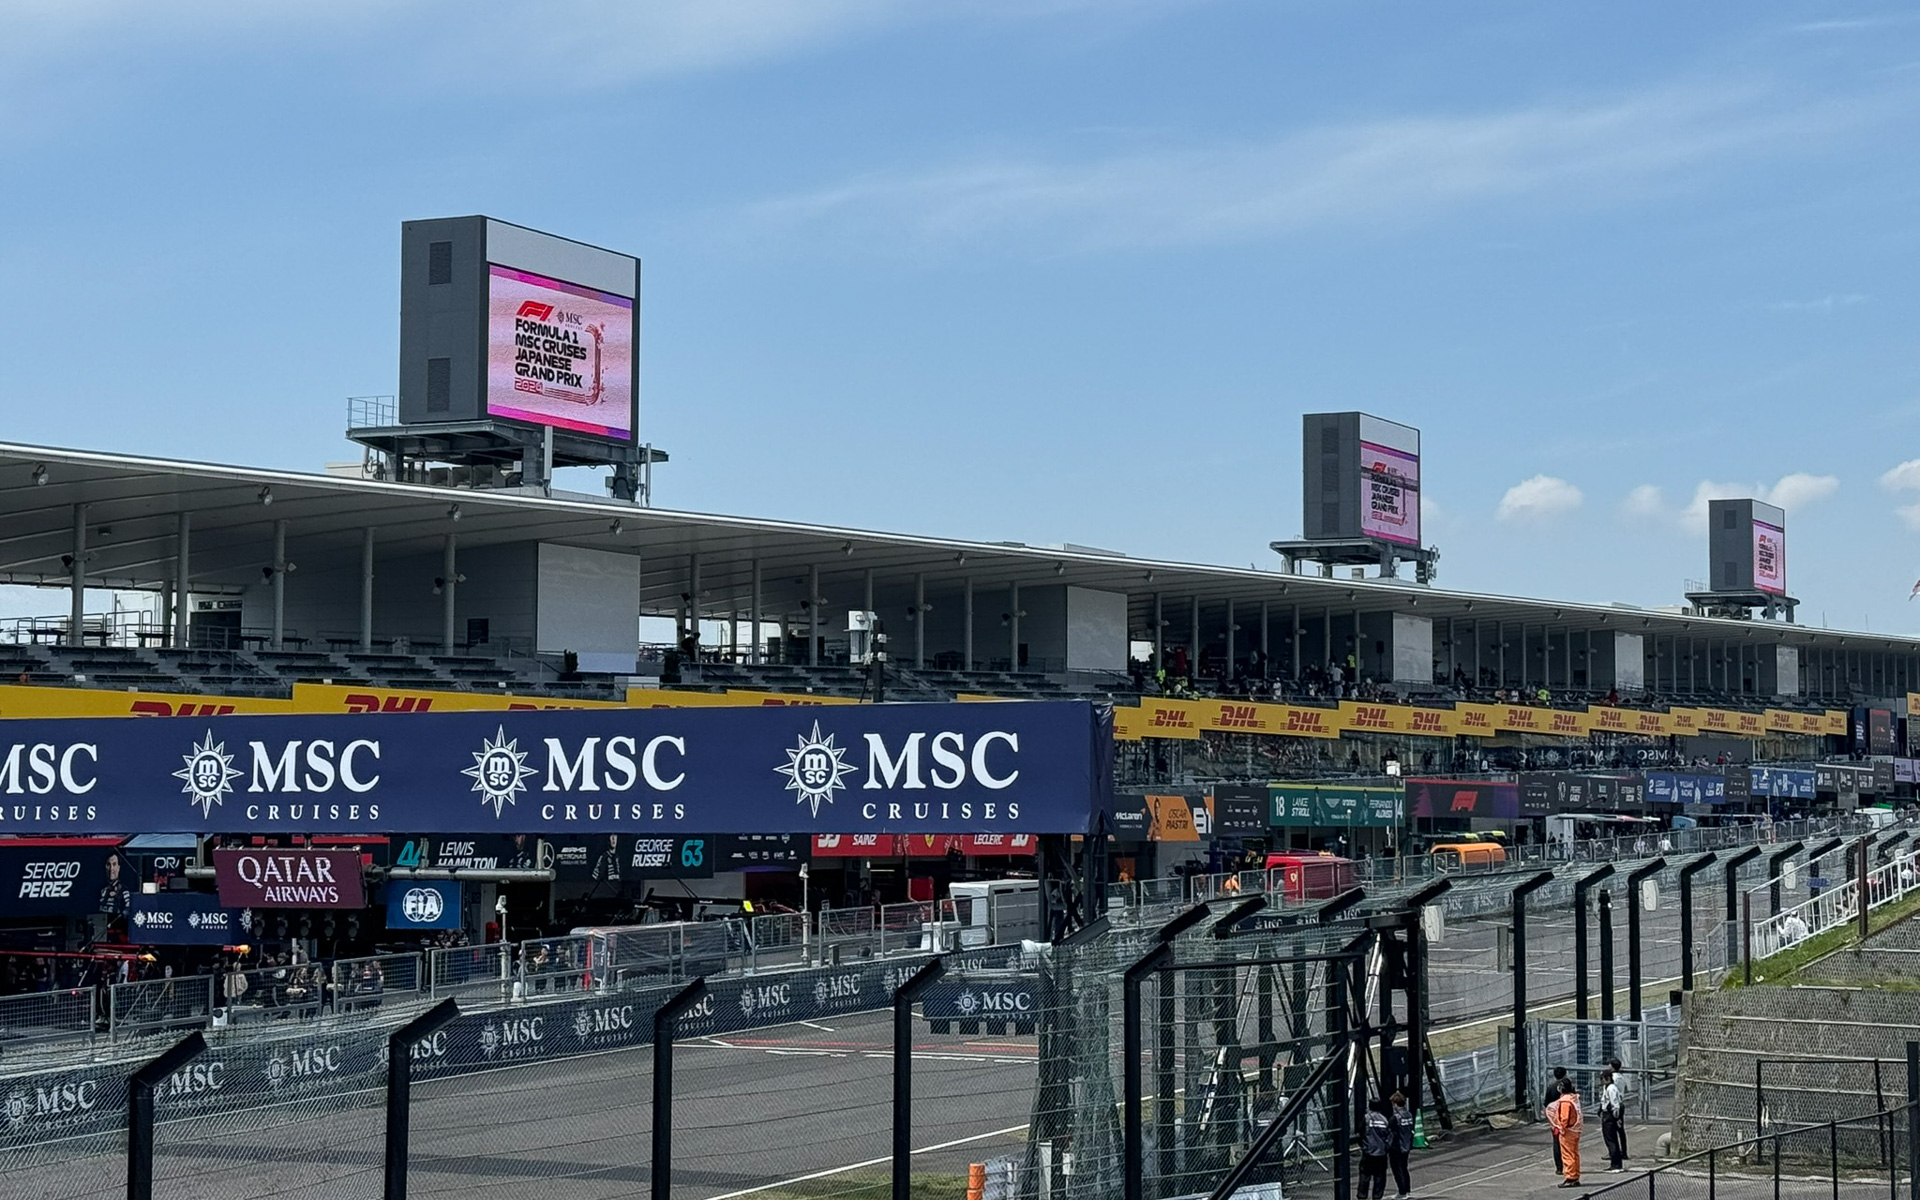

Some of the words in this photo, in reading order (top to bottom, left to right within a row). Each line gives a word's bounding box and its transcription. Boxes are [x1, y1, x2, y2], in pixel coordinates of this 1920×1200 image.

[516, 301, 555, 321] F1
[566, 312, 582, 325] MSC
[515, 318, 571, 342] FORMULA
[572, 332, 579, 344] 1
[515, 334, 540, 349] MSC
[542, 340, 586, 360] CRUISES
[515, 348, 572, 371] JAPANESE
[515, 363, 555, 383] GRAND
[556, 371, 583, 388] PRIX
[514, 378, 544, 394] 2024
[1155, 709, 1187, 727] DHL
[1220, 705, 1258, 728] DHL
[1288, 711, 1322, 732] DHL
[1356, 707, 1388, 728] DHL
[1412, 712, 1441, 732] DHL
[1465, 712, 1486, 727] DHL
[1508, 709, 1534, 728] DHL
[1554, 714, 1578, 732] DHL
[248, 740, 380, 793] MSC
[542, 735, 686, 792] MSC
[863, 731, 1019, 789] MSC
[1649, 779, 1654, 793] 2
[862, 802, 1019, 820] CRUISES
[1275, 796, 1285, 816] 18
[1292, 798, 1309, 806] LANCE
[247, 804, 380, 820] CRUISES
[542, 803, 685, 820] CRUISES
[1114, 812, 1142, 821] McLaren
[1168, 808, 1187, 819] OSCAR
[1291, 808, 1310, 817] STROLL
[1375, 810, 1392, 818] ALONSO
[1166, 820, 1188, 829] PIASTRI
[635, 839, 674, 852] GEORGE
[852, 834, 877, 846] SAINZ
[974, 834, 1004, 845] LECLERC
[439, 842, 475, 856] LEWIS
[682, 840, 704, 867] 63
[23, 861, 81, 879] SERGIO
[238, 856, 336, 888] QATAR
[19, 881, 72, 898] PEREZ
[265, 886, 338, 903] AIRWAYS
[147, 912, 173, 923] MSC
[201, 912, 228, 925] MSC
[830, 974, 860, 998] MSC
[758, 984, 790, 1008] MSC
[982, 992, 1030, 1010] MSC
[594, 1005, 632, 1032] MSC
[502, 1017, 543, 1046] MSC
[291, 1046, 340, 1077] MSC
[170, 1062, 223, 1095] MSC
[35, 1080, 95, 1116] MSC
